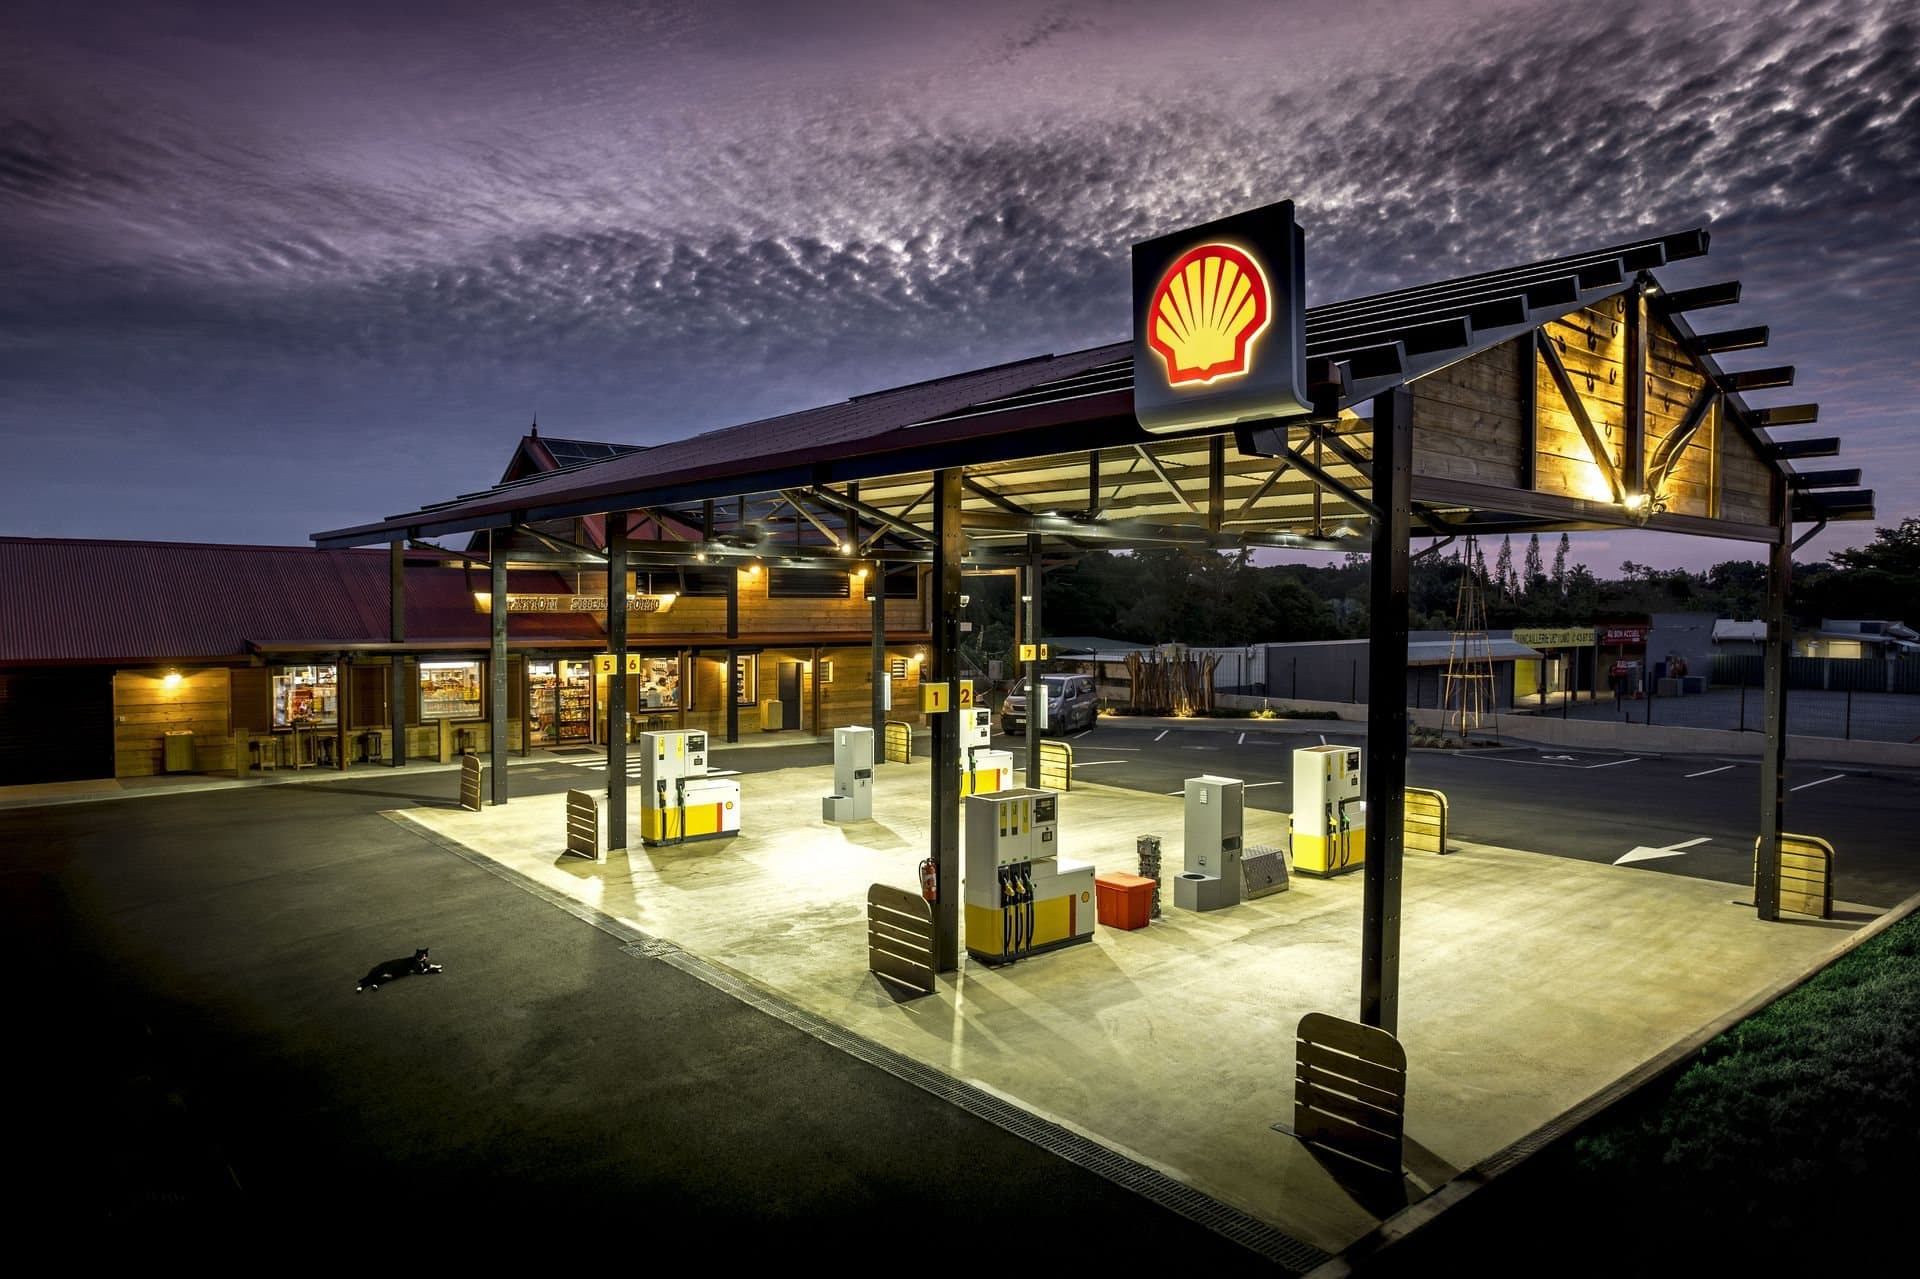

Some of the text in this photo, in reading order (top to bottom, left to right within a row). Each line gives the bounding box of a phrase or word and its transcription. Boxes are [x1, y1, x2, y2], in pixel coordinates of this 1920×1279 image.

[1026, 649, 1032, 657] 7
[603, 660, 611, 671] 5
[629, 660, 637, 670] 6
[933, 691, 939, 707] 1
[960, 688, 970, 704] 2
